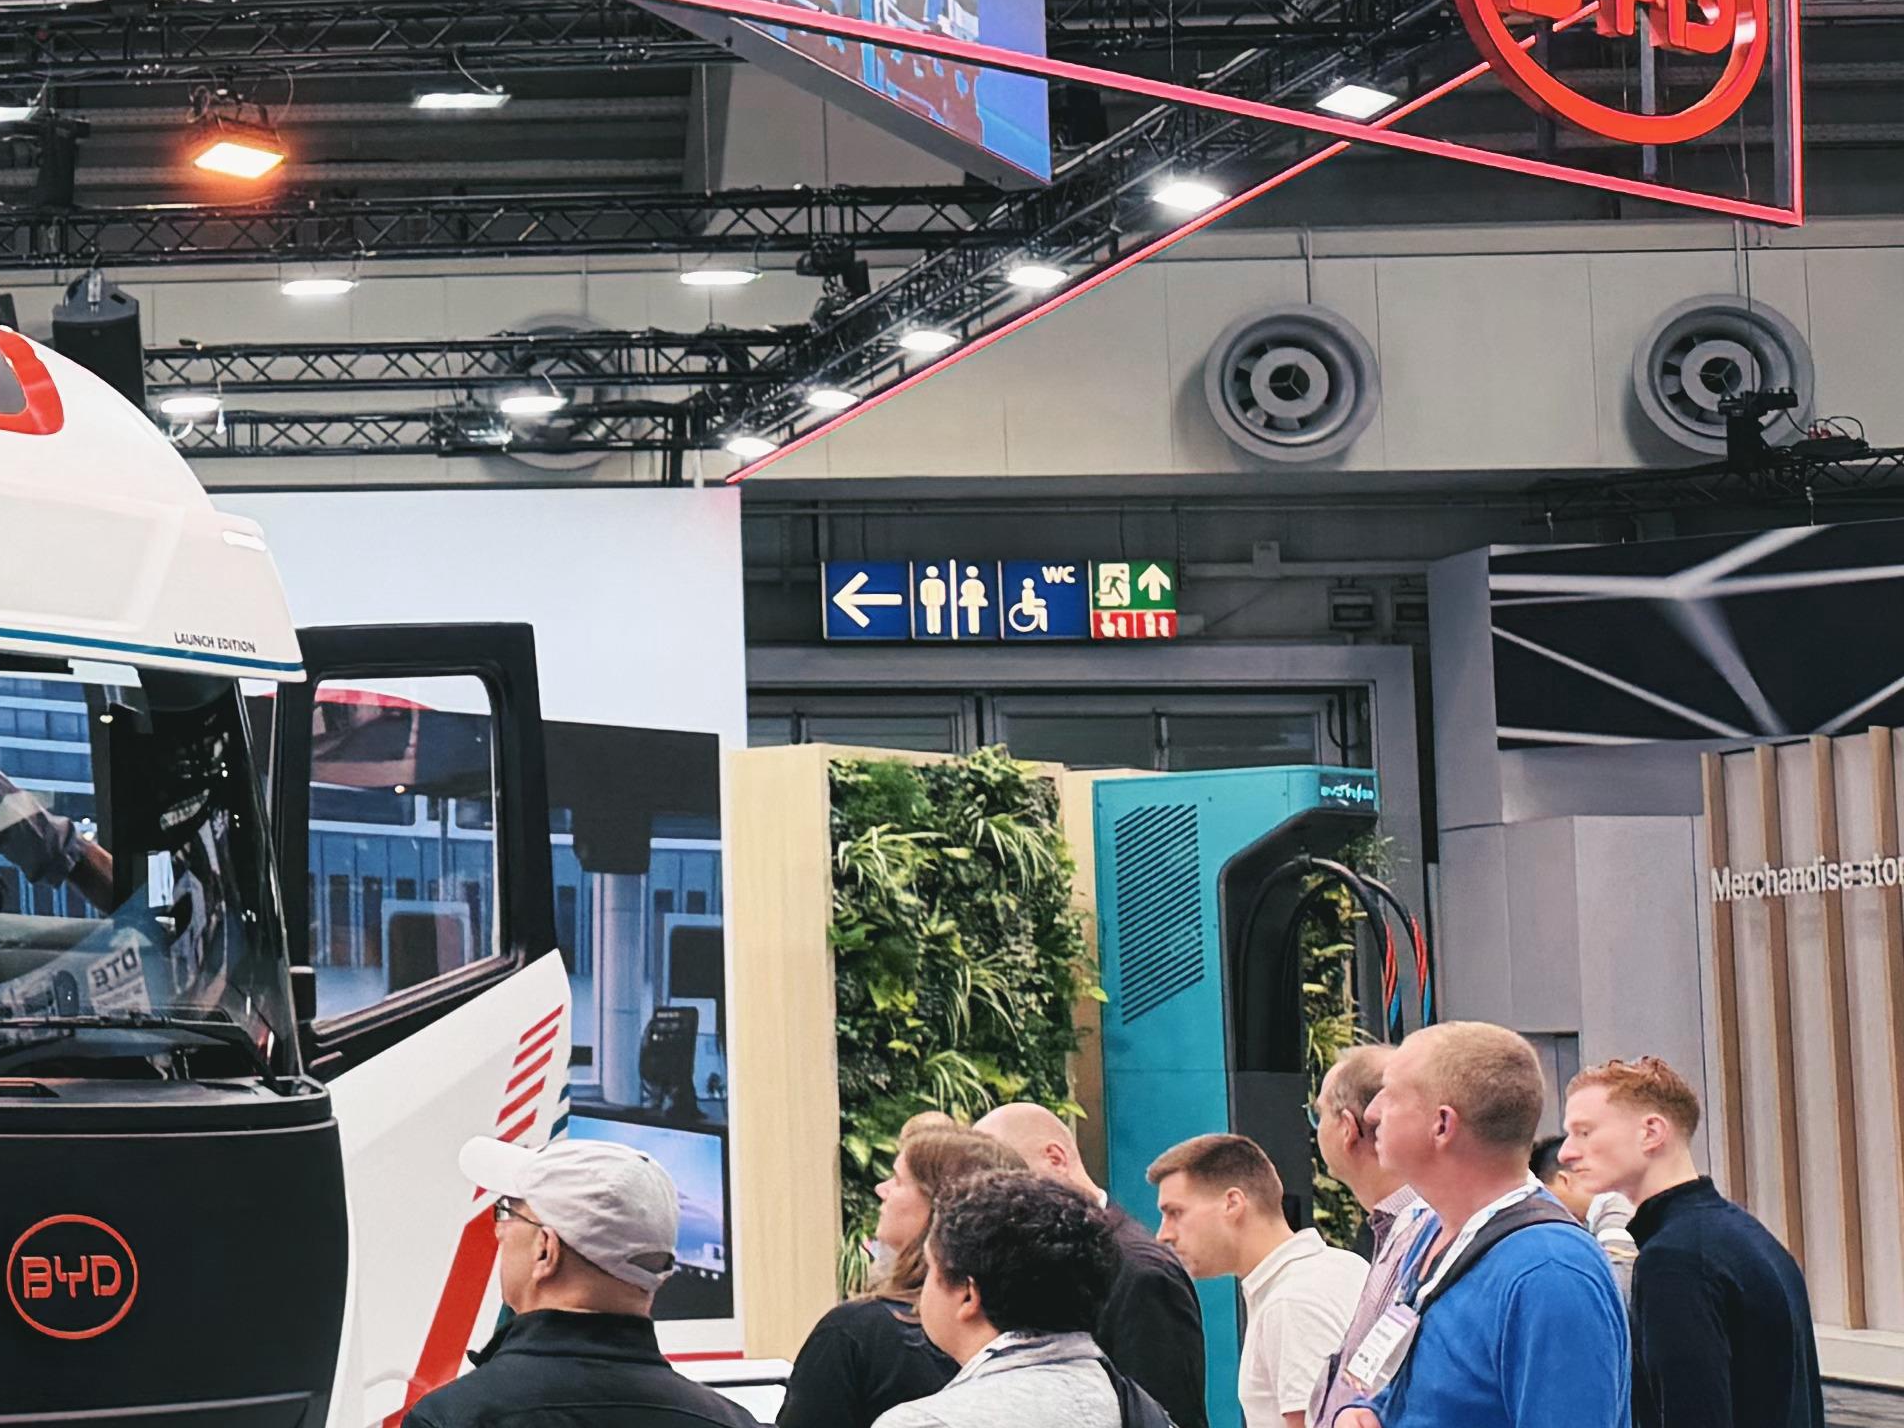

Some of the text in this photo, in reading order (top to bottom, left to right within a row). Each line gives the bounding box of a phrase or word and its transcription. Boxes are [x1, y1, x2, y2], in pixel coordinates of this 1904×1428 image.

[1042, 565, 1076, 584] WC
[174, 632, 256, 653] LAUNCH EDITION
[1711, 855, 1854, 902] Merchandise
[22, 1255, 122, 1299] BYD
